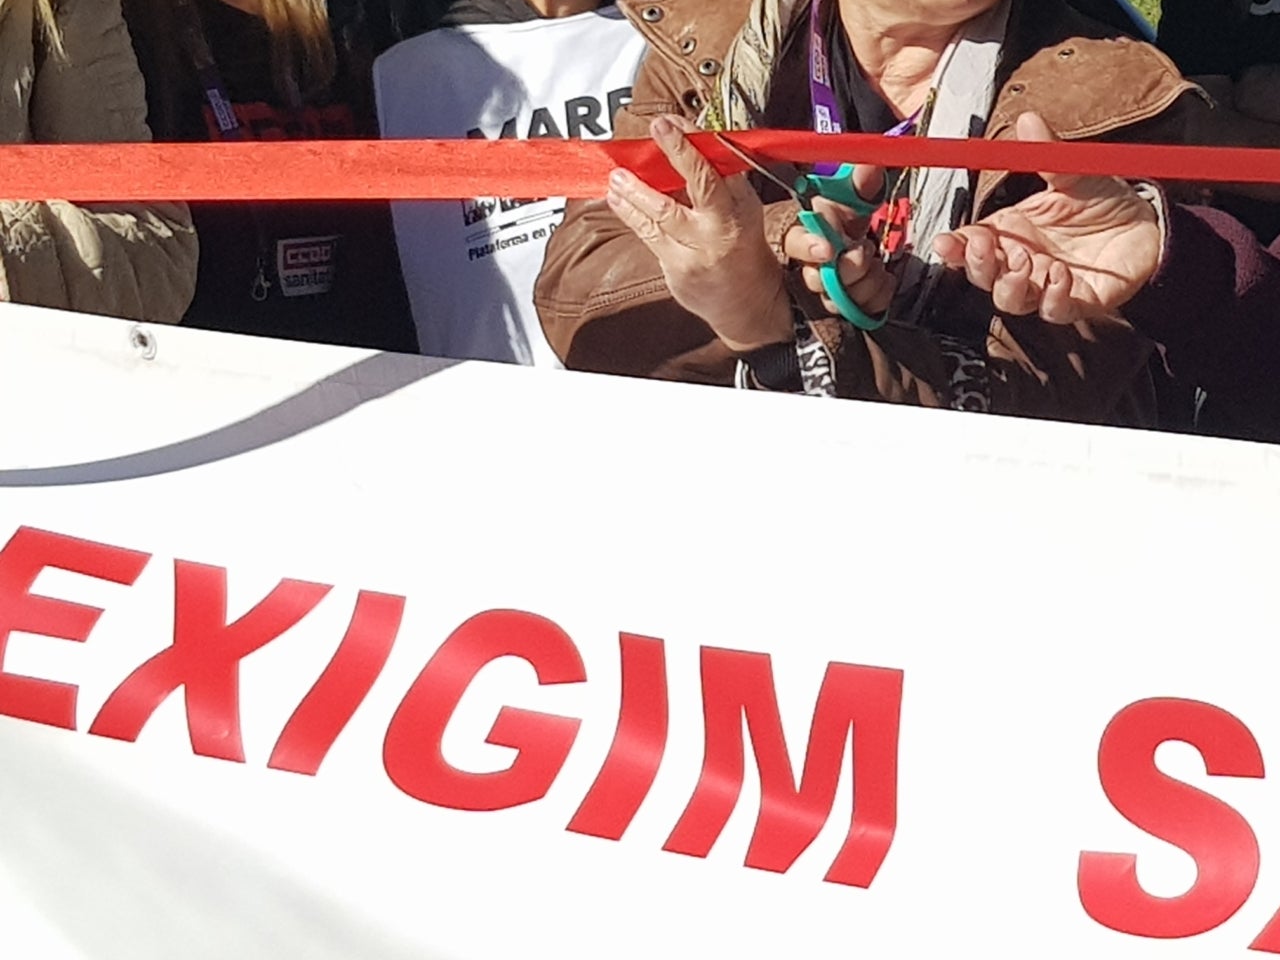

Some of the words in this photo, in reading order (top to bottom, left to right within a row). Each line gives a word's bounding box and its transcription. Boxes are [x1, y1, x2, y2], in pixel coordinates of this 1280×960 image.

[468, 233, 529, 261] Plataforma
[532, 228, 547, 240] en
[0, 526, 904, 889] EXIGIM
